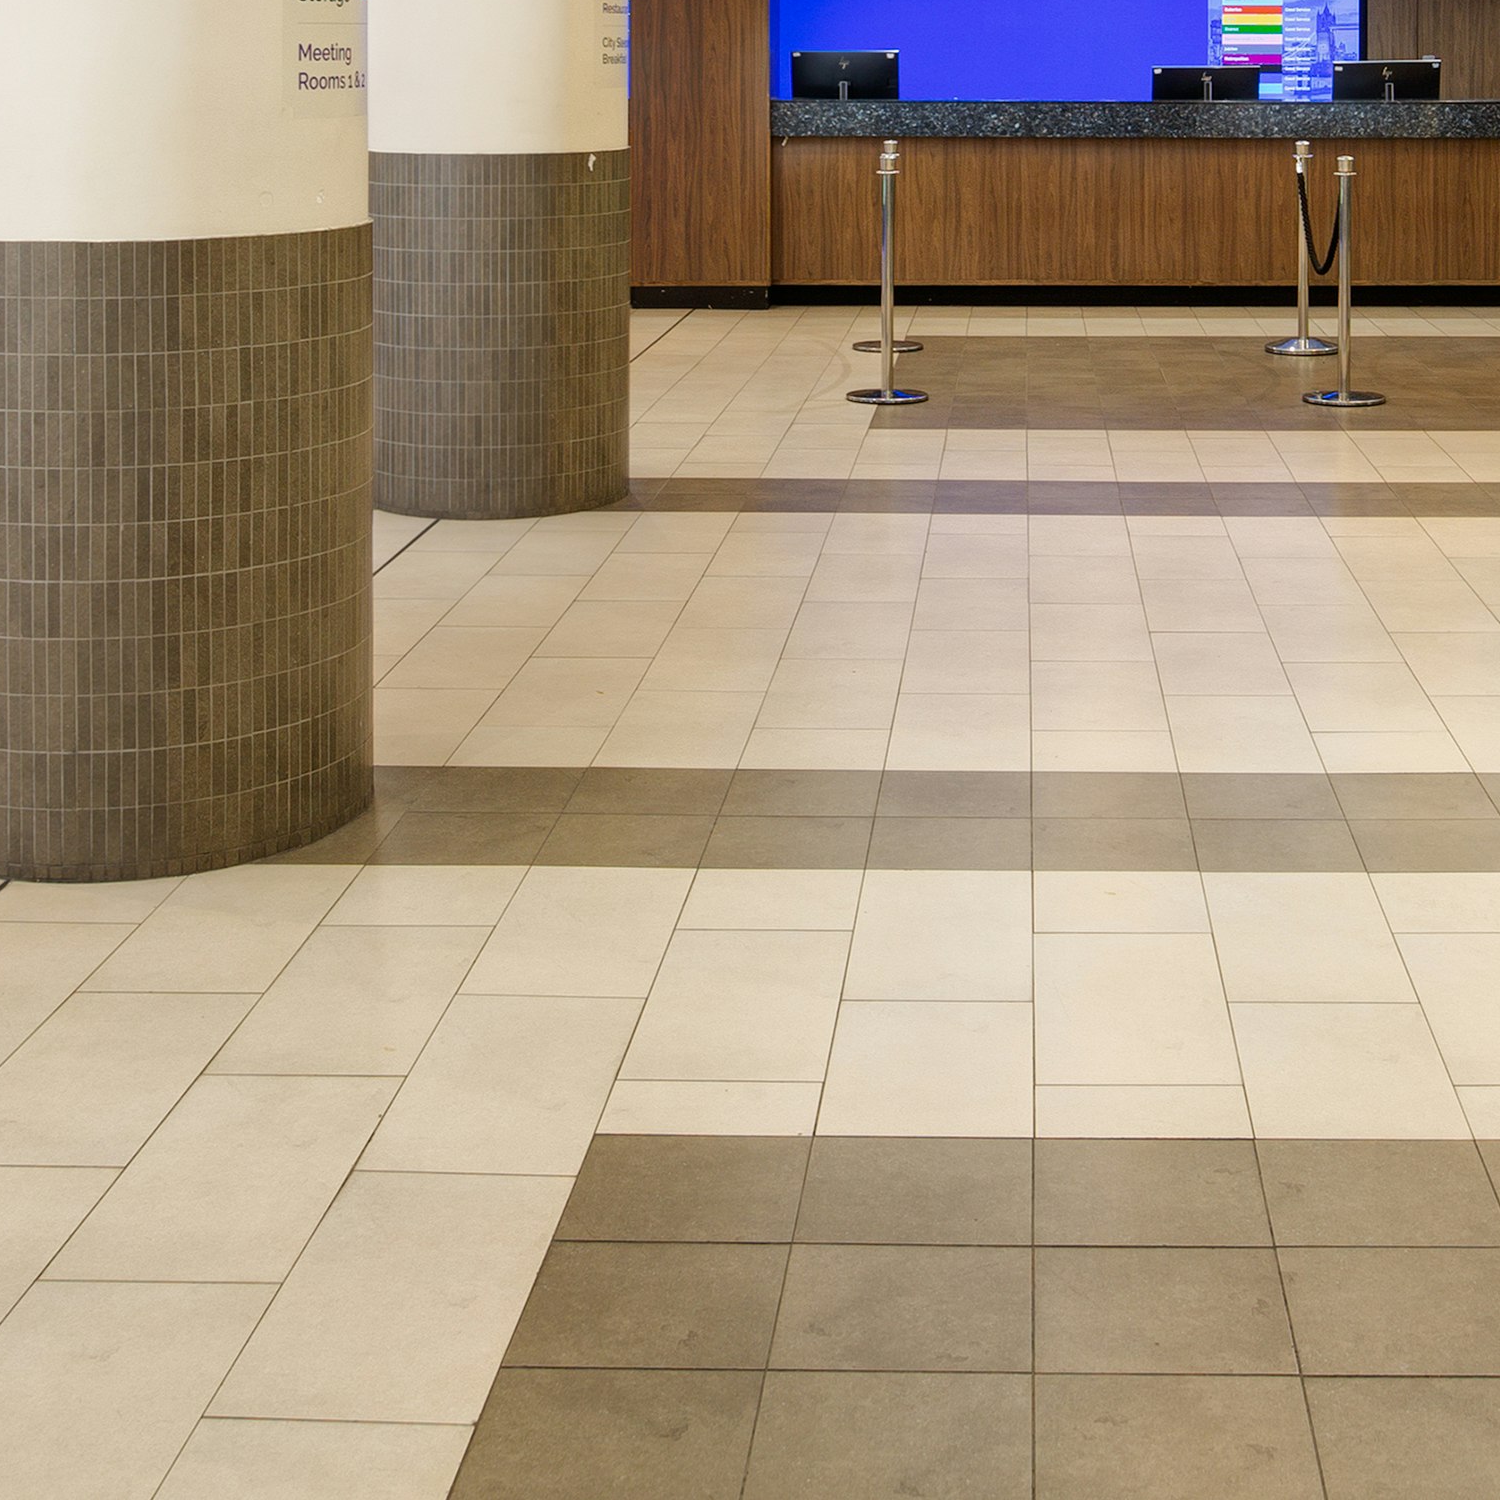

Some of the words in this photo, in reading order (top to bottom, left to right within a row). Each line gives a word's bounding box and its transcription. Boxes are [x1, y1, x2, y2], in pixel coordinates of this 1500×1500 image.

[298, 42, 352, 66] Meeting
[298, 72, 346, 90] Rooms
[348, 75, 353, 89] 1
[355, 71, 360, 88] &
